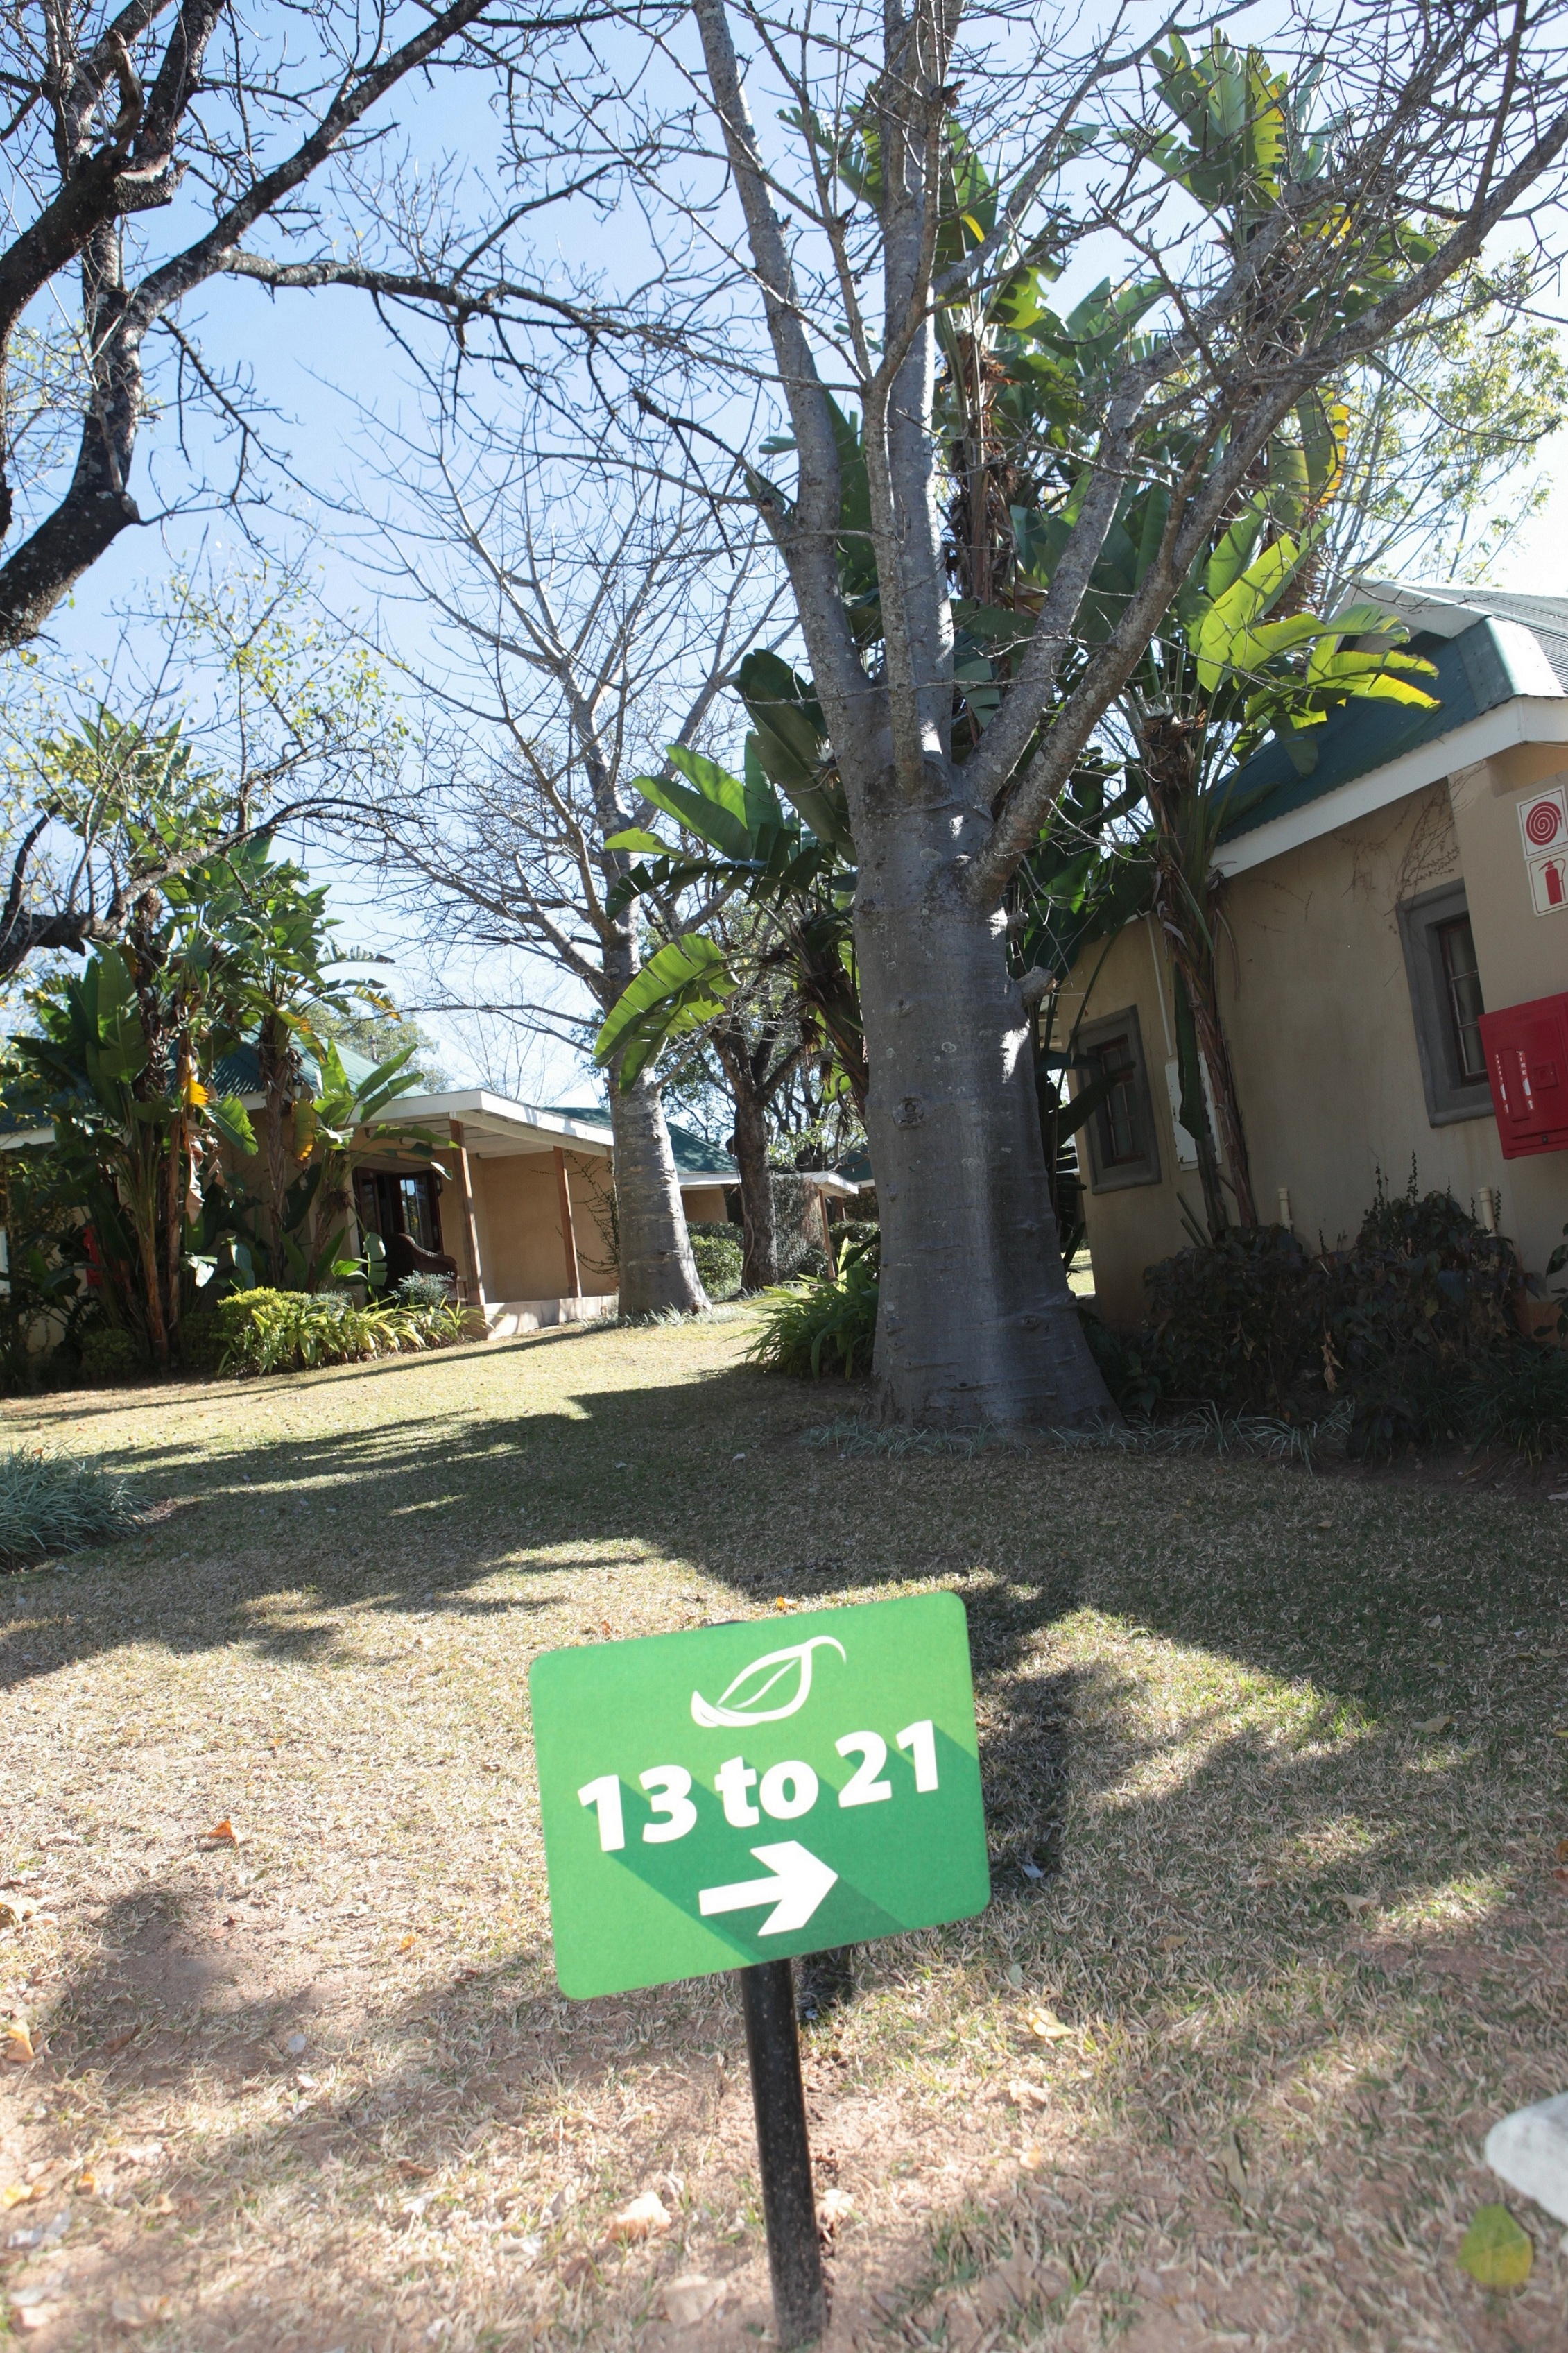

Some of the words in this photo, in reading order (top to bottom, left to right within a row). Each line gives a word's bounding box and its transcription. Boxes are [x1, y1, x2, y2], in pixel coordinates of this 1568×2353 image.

[577, 1764, 698, 1851] 13
[714, 1755, 819, 1828] to
[835, 1720, 938, 1808] 21
